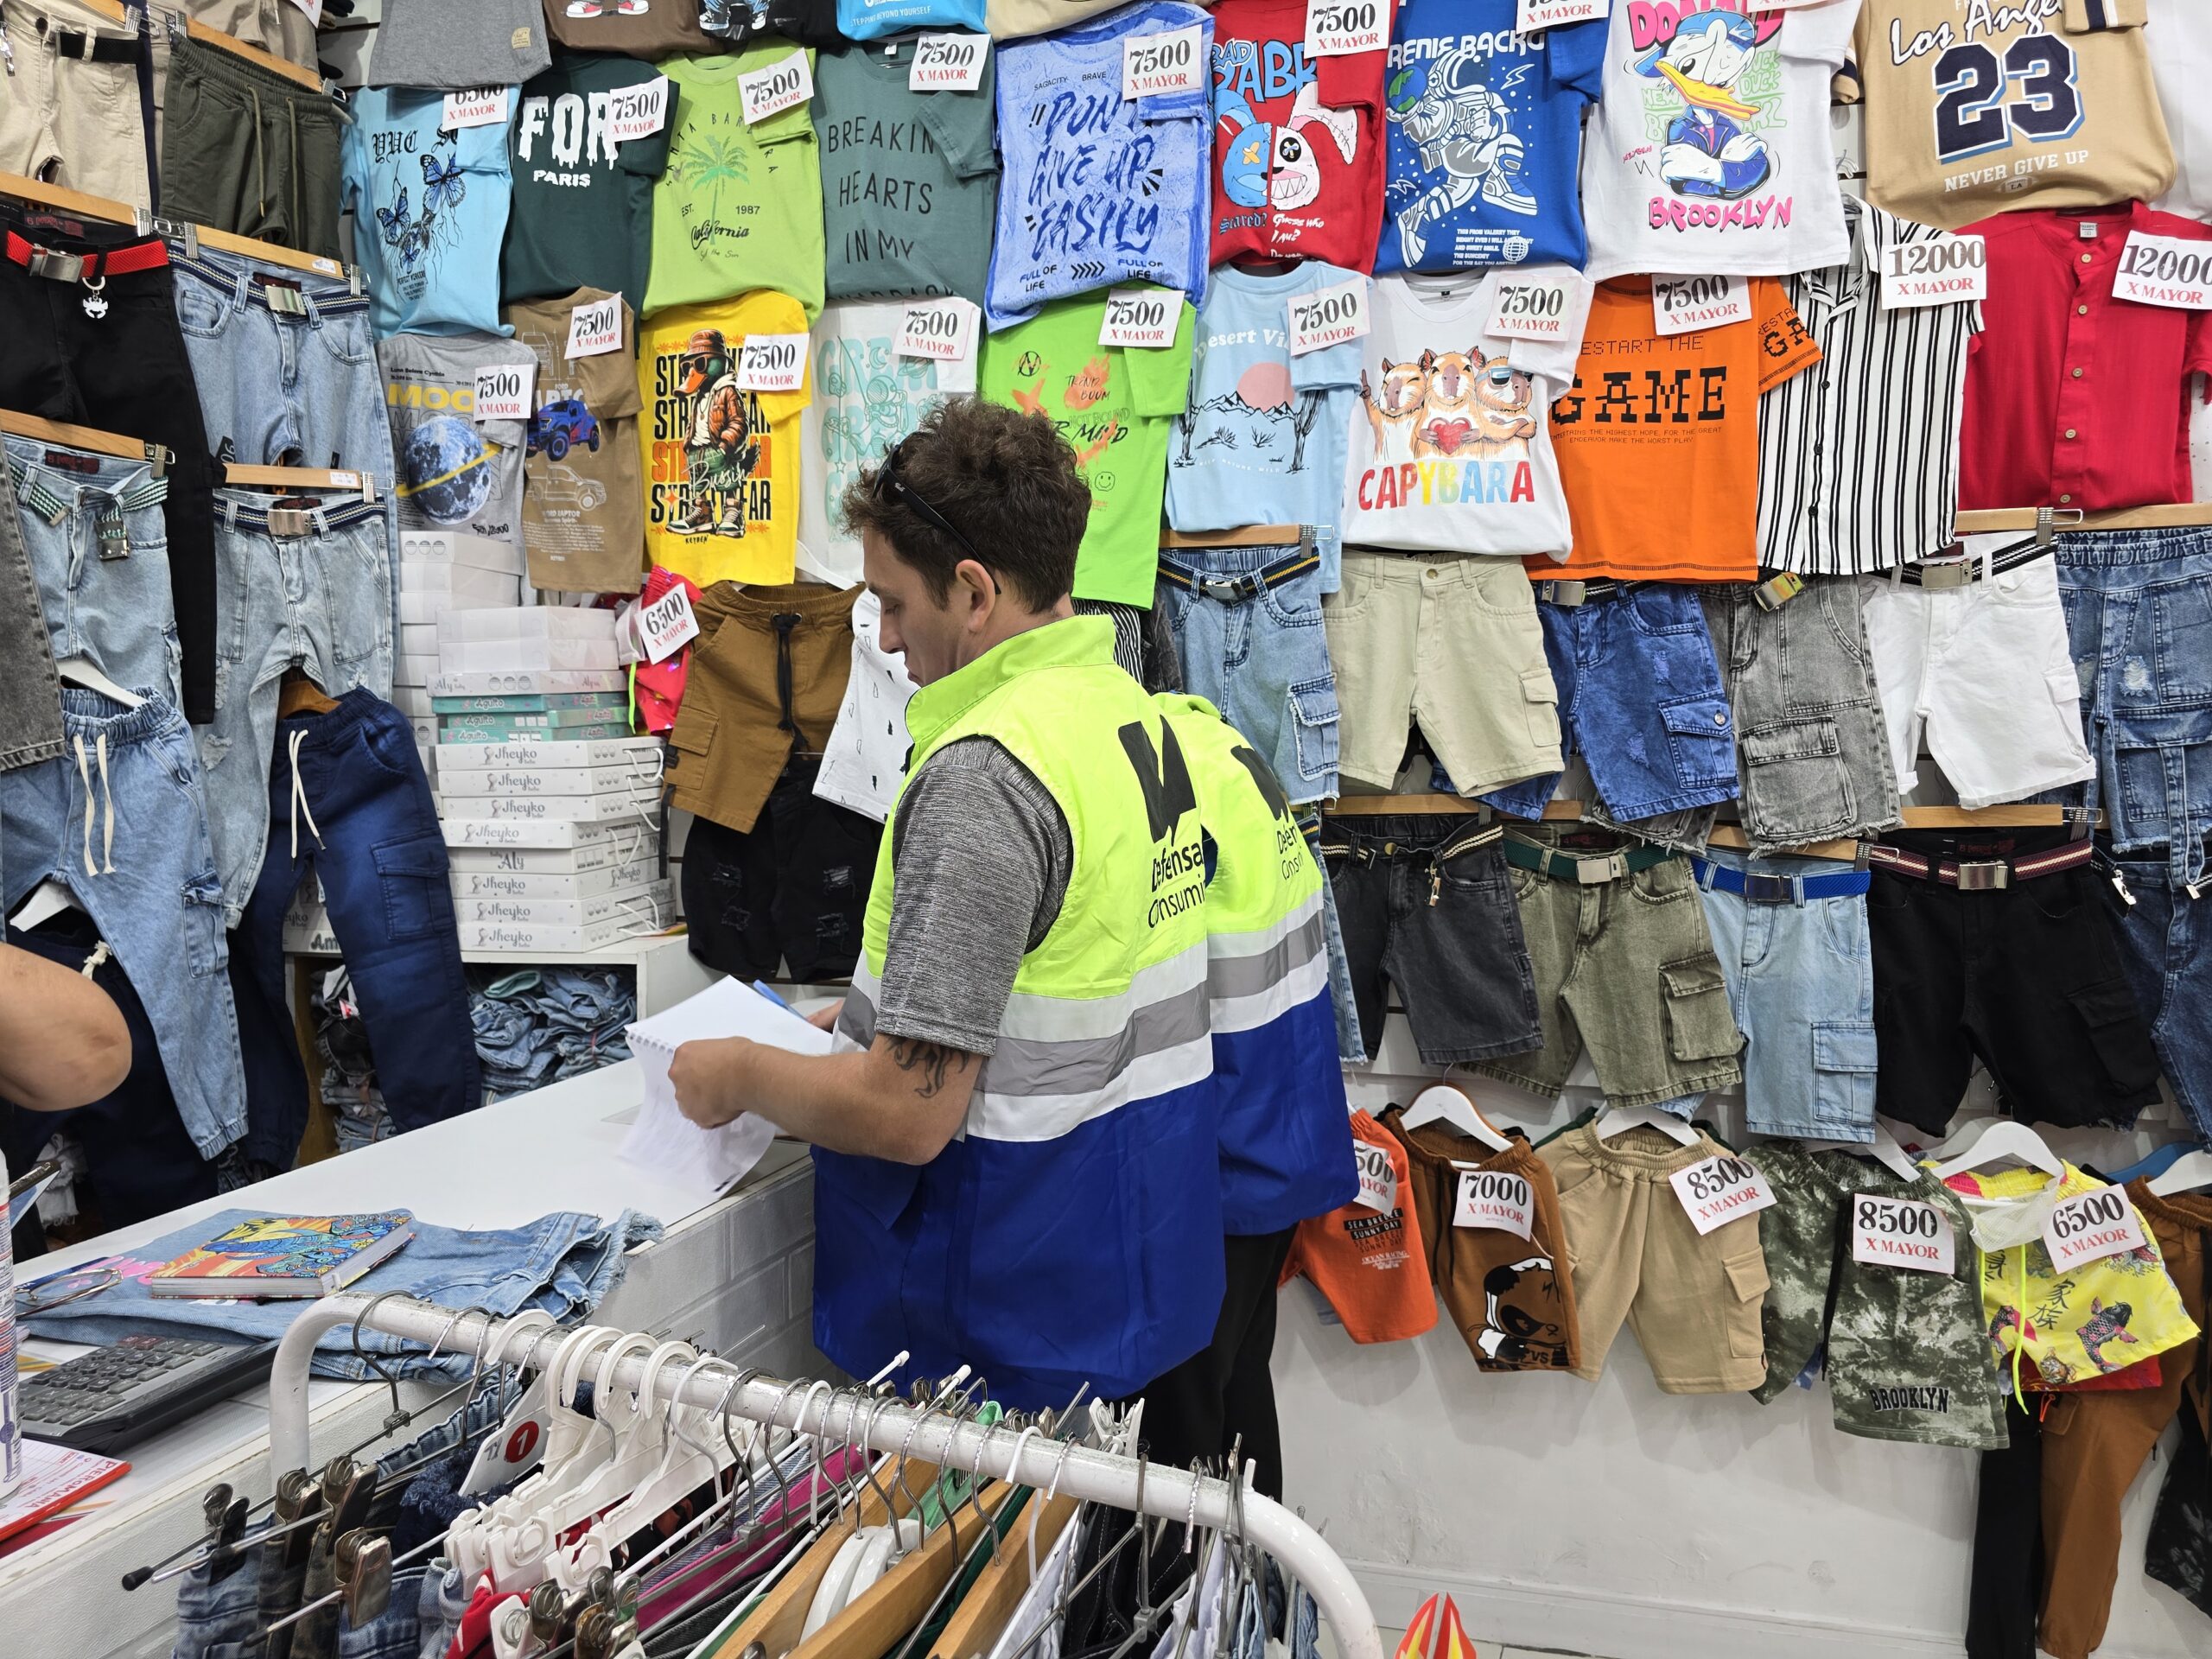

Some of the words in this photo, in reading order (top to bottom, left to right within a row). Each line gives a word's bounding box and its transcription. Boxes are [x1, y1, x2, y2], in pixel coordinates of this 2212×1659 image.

[899, 5, 931, 16] YOURSELF
[1313, 3, 1376, 34] 7500
[1527, 13, 1536, 24] X
[1540, 4, 1592, 21] MAYOR
[919, 36, 975, 67] 7500
[1318, 39, 1327, 50] X
[1331, 33, 1378, 48] MAYOR
[1890, 17, 1955, 66] Los
[1129, 40, 1191, 75] 7500
[1751, 50, 1782, 72] UCK
[746, 67, 800, 105] 7500
[917, 70, 925, 82] X
[927, 69, 968, 81] MAYOR
[1034, 76, 1068, 91] SAGACITY
[1082, 71, 1107, 81] BRAVE
[1130, 79, 1140, 91] X
[1142, 73, 1187, 89] MAYOR
[1738, 71, 1782, 93] DUCK
[612, 91, 660, 121] 7500
[751, 106, 759, 115] X
[761, 91, 801, 111] MAYOR
[1641, 89, 1681, 105] NEW
[1932, 32, 2085, 164] 23
[449, 111, 456, 120] X
[459, 104, 495, 118] MAYOR
[613, 124, 620, 134] X
[622, 119, 655, 134] MAYOR
[828, 116, 934, 155] BREAKIN
[533, 170, 591, 188] PARIS
[1028, 144, 1096, 207] GIVE
[1104, 134, 1154, 192] UP
[1945, 164, 2007, 193] NEVER
[2014, 154, 2059, 175] GIVE
[2065, 149, 2088, 164] UP
[839, 170, 933, 214] HEARTS
[682, 204, 694, 217] EST.
[735, 206, 760, 215] 1987
[1649, 194, 1793, 232] BROOKLYN
[691, 219, 750, 250] California
[1032, 192, 1159, 261] EASILY
[846, 229, 869, 264] IN
[878, 229, 914, 260] MY
[1118, 258, 1146, 267] FULL
[1888, 240, 1986, 277] 12000
[1020, 270, 1040, 283] FULL
[1042, 264, 1058, 275] OF
[1127, 269, 1151, 279] LIFE
[1026, 281, 1046, 292] LIFE
[1656, 274, 1729, 312] 7500
[1897, 283, 1910, 295] X
[1914, 277, 1974, 294] MAYOR
[2126, 282, 2138, 296] X
[2142, 285, 2203, 304] MAYOR
[1294, 293, 1357, 331] 7500
[1500, 286, 1563, 316] 7500
[574, 307, 613, 338] 7500
[906, 310, 957, 337] 7500
[1108, 300, 1165, 327] 7500
[1669, 314, 1681, 325] X
[1685, 304, 1738, 323] MAYOR
[1110, 329, 1118, 340] X
[1122, 329, 1164, 340] MAYOR
[1298, 334, 1306, 346] X
[1311, 327, 1355, 343] MAYOR
[1497, 319, 1507, 328] X
[1512, 319, 1559, 332] MAYOR
[575, 339, 582, 347] X
[586, 332, 615, 346] MAYOR
[905, 336, 912, 346] X
[914, 337, 955, 355] MAYOR
[1194, 328, 1256, 359] Desert
[1581, 338, 1656, 355] ESTART
[1667, 335, 1704, 353] THE
[745, 344, 795, 370] 7500
[477, 373, 520, 399] 7500
[747, 374, 754, 385] X
[758, 375, 794, 385] MAYOR
[1552, 365, 1727, 425] GAME
[479, 404, 485, 414] X
[486, 403, 520, 414] MAYOR
[1358, 461, 1535, 511] CAPYBARA
[645, 593, 684, 635] 6500
[654, 638, 661, 648] X
[663, 619, 689, 645] MAYOR
[495, 747, 537, 765] Jheyko
[498, 773, 541, 792] Jheyko
[502, 800, 545, 819] Jheyko
[476, 826, 519, 843] Jheyko
[498, 852, 524, 871] Aly
[483, 877, 525, 896] Jheyko
[487, 904, 531, 922] Jheyko
[489, 931, 532, 949] Jheyko
[1465, 1174, 1527, 1206] 7000
[1687, 1158, 1754, 1201] 8500
[1468, 1203, 1476, 1214] X
[1480, 1204, 1524, 1224] MAYOR
[1697, 1207, 1711, 1222] X
[1712, 1186, 1759, 1215] MAYOR
[2053, 1192, 2125, 1238] 6500
[1348, 1221, 1363, 1230] SEA
[1353, 1227, 1380, 1239] SUNNY
[1383, 1220, 1399, 1230] DAY
[1859, 1201, 1938, 1237] 8500
[1866, 1238, 1878, 1251] X
[1881, 1241, 1939, 1260] MAYOR
[2060, 1245, 2073, 1258] X
[2075, 1228, 2130, 1252] MAYOR
[1869, 1386, 1950, 1414] BROOKLYN
